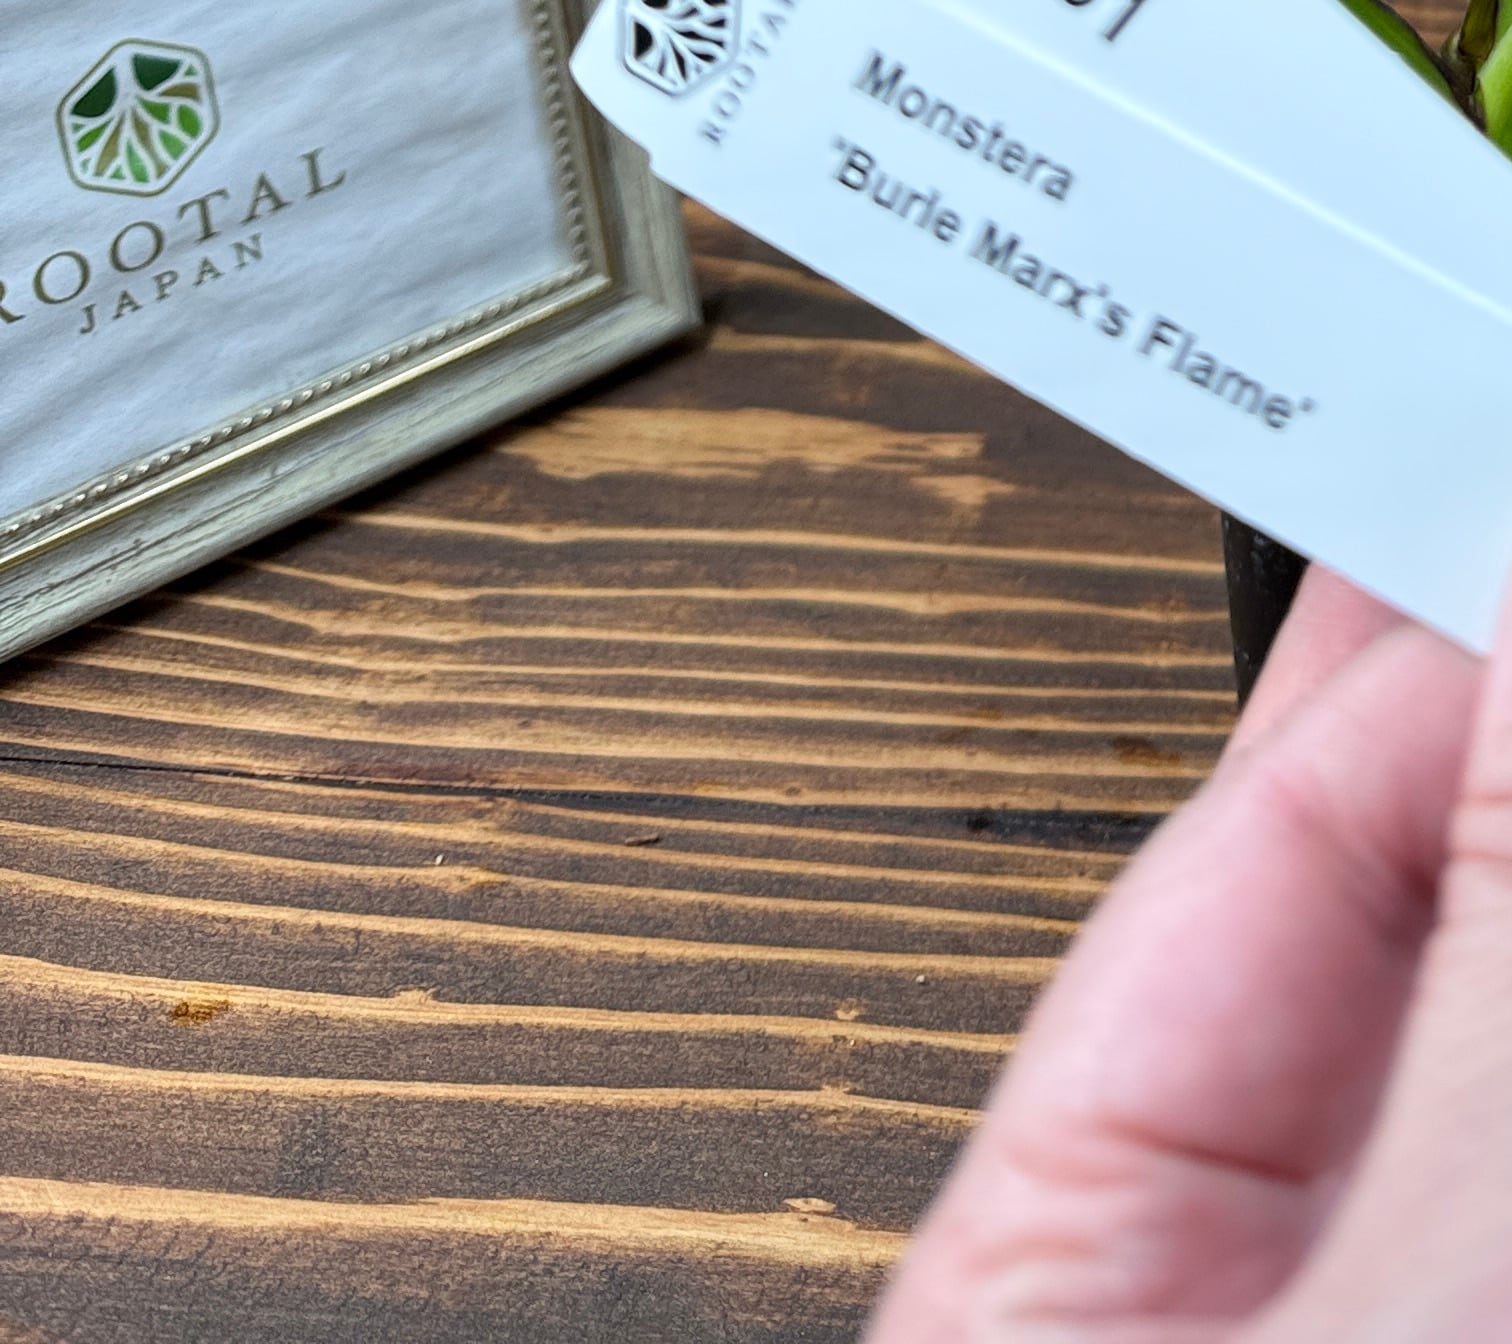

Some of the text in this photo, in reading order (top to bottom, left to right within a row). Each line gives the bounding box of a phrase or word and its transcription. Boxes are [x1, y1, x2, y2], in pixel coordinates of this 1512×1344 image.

[852, 50, 1075, 201] Monstera
[79, 233, 265, 334] JAPAN
[968, 218, 1130, 338] Marx's
